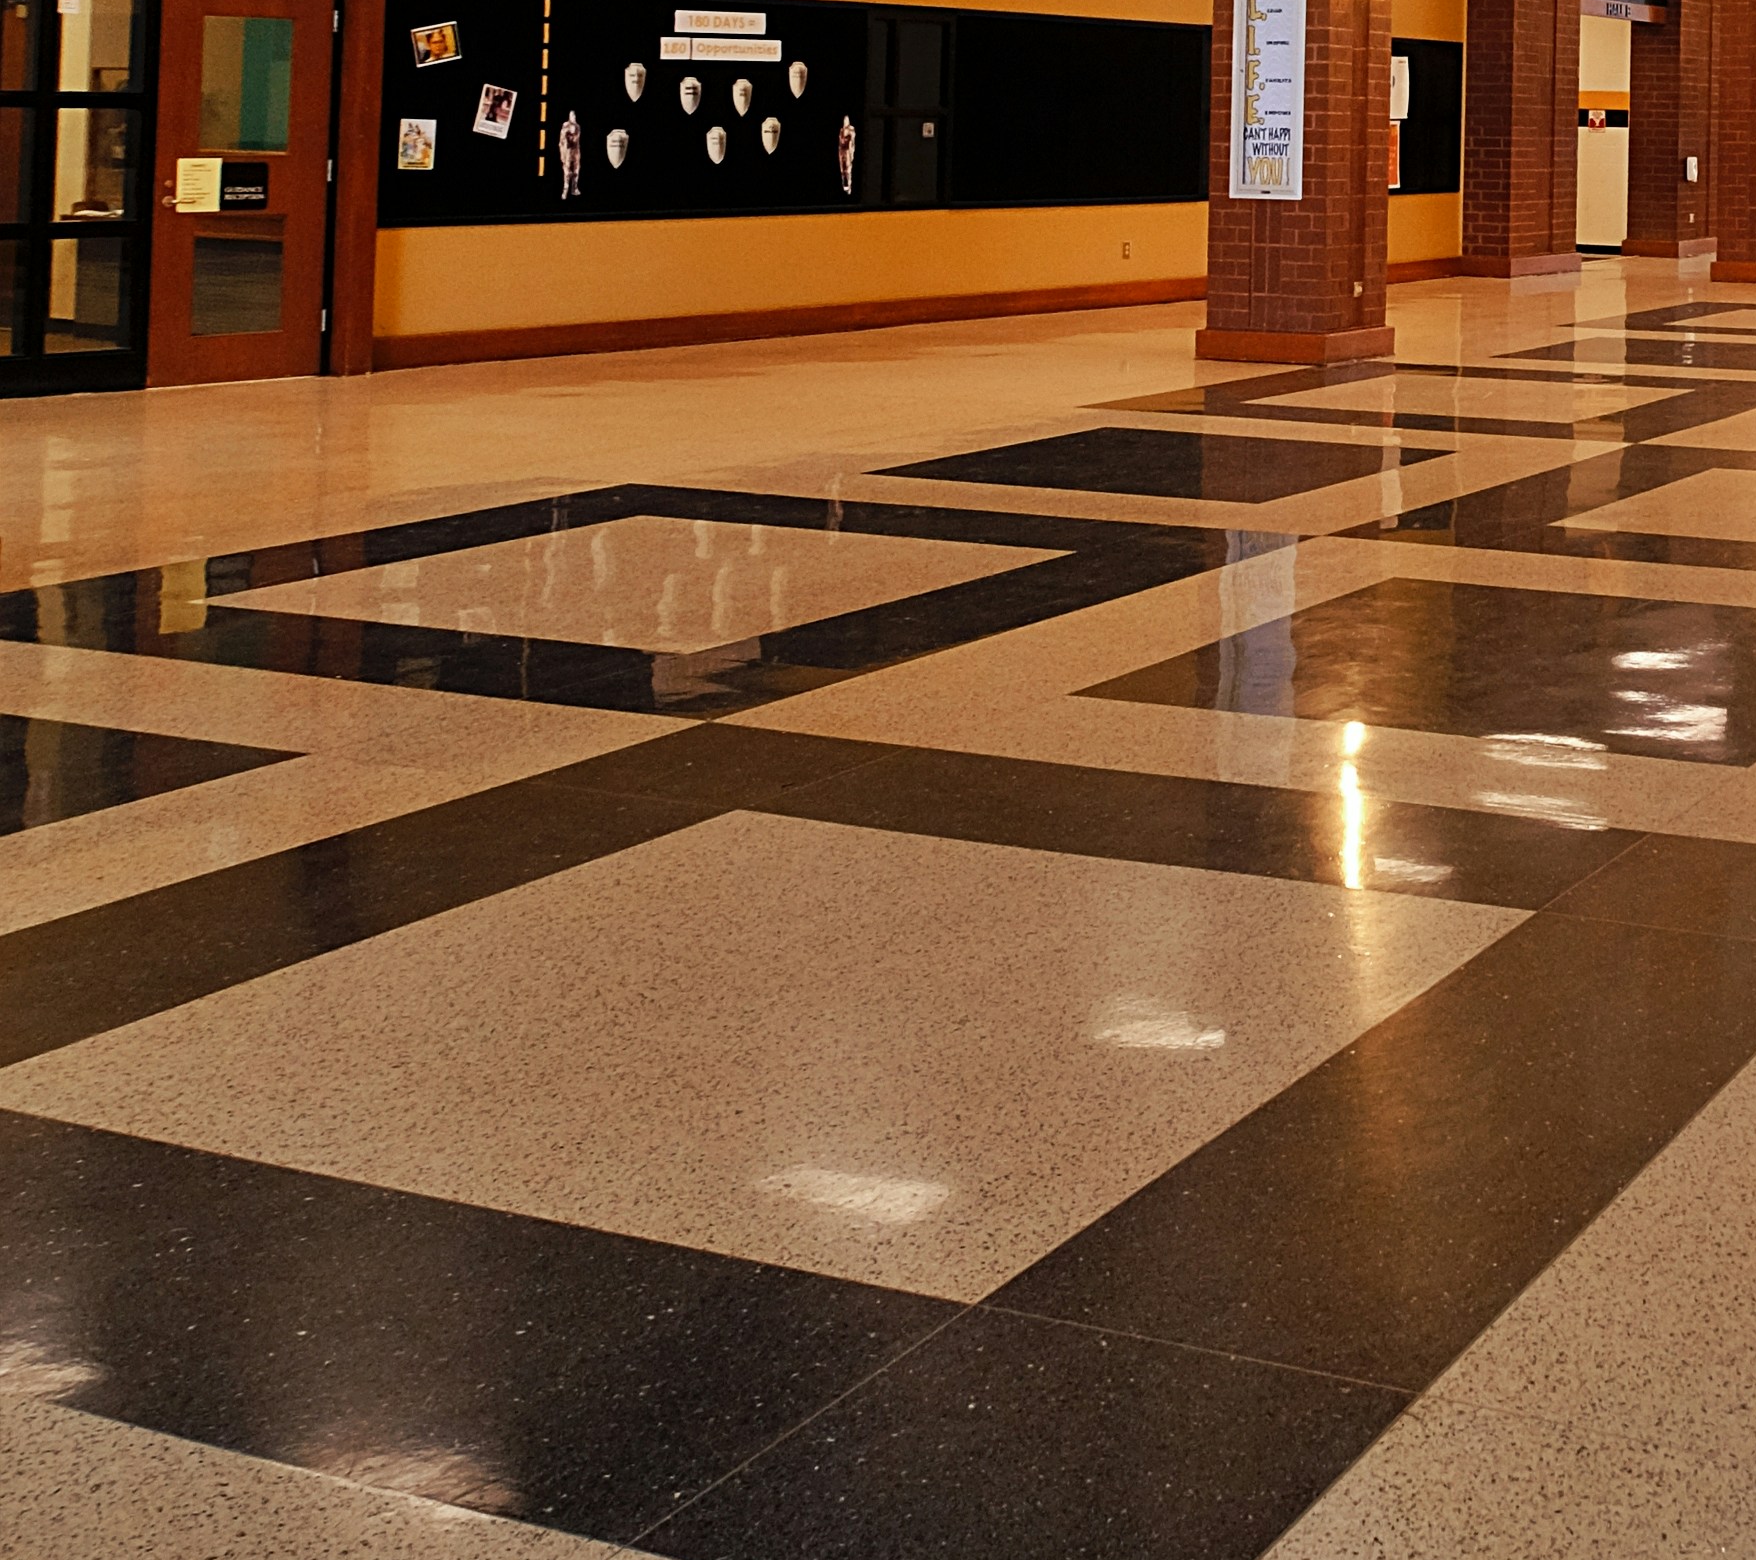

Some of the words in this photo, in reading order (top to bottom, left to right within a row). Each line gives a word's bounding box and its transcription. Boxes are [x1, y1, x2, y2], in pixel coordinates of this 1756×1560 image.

[688, 15, 709, 28] 180
[713, 15, 745, 29] DAYS
[696, 43, 778, 57] Opportunities
[1252, 142, 1289, 157] WITHOUT
